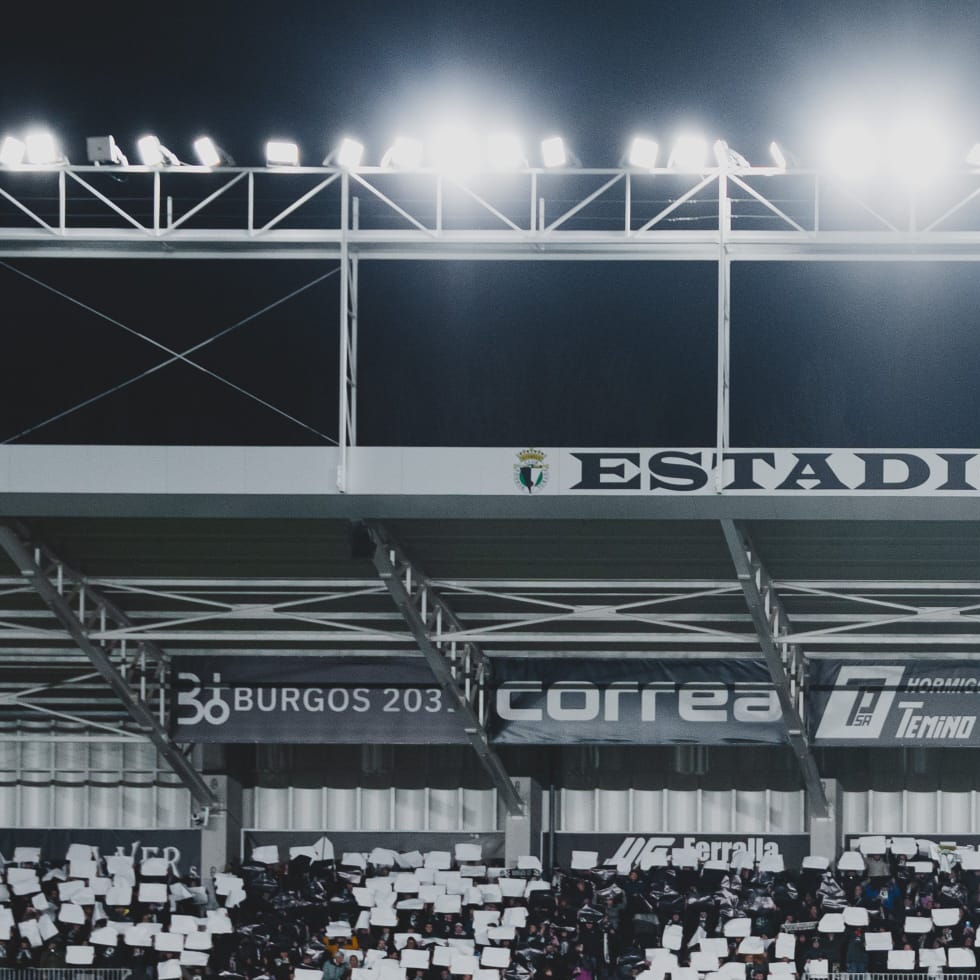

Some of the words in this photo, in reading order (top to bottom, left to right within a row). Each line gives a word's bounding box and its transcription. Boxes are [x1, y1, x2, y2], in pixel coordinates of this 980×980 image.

[234, 687, 371, 712] BURGOS
[383, 687, 456, 713] 203
[496, 681, 783, 722] correa
